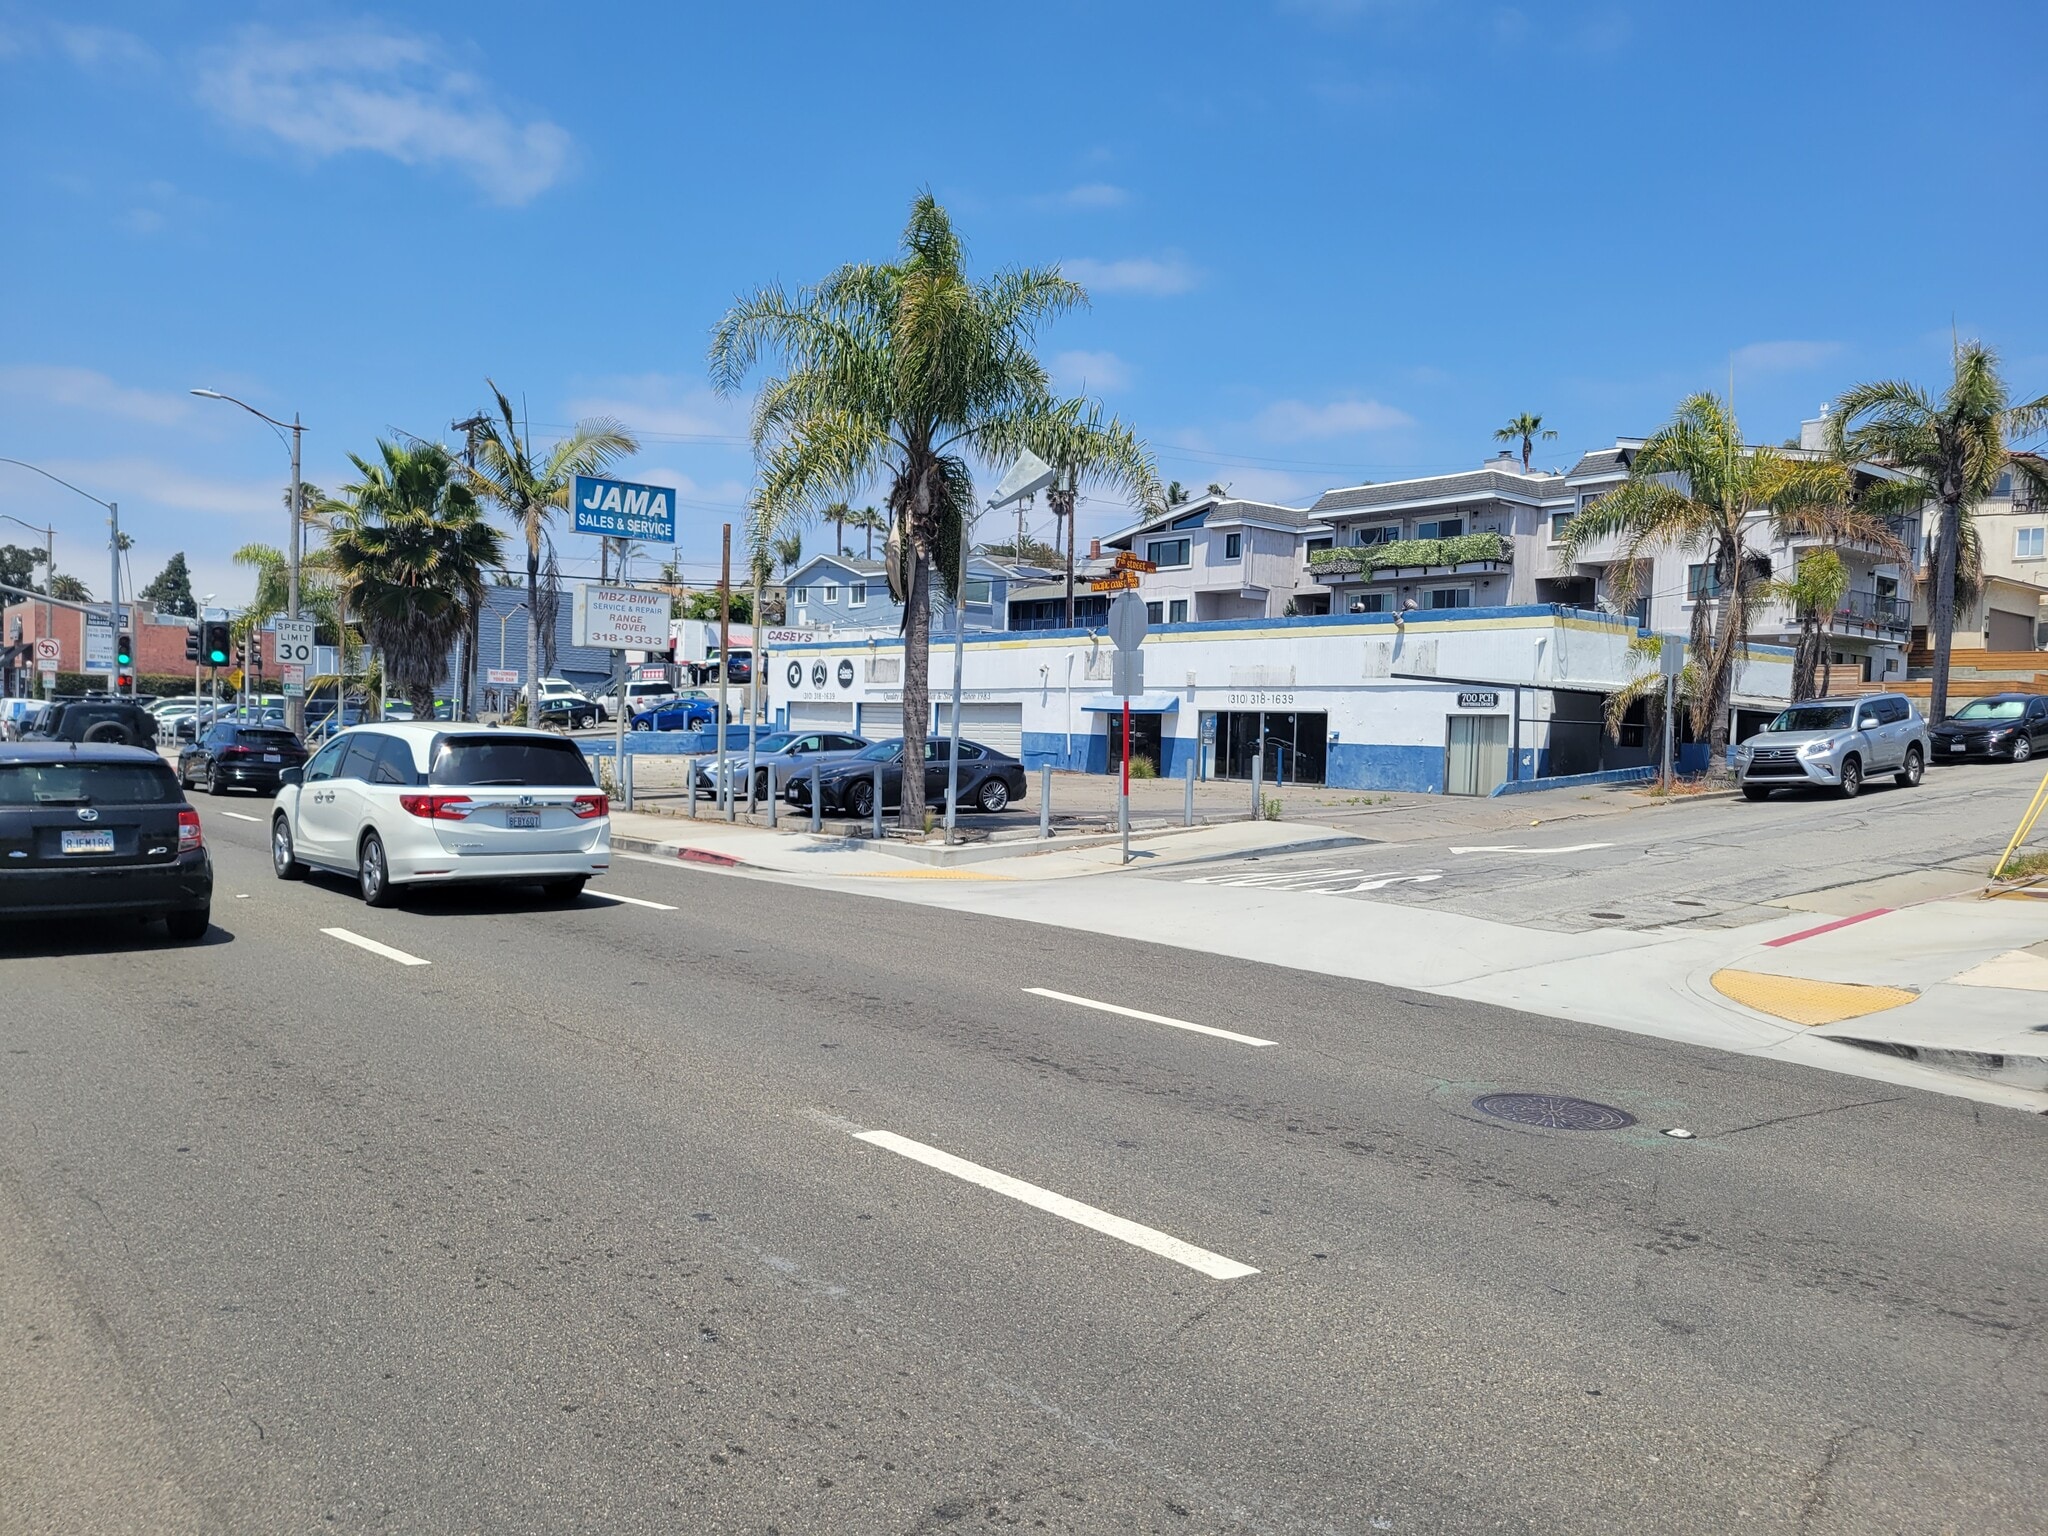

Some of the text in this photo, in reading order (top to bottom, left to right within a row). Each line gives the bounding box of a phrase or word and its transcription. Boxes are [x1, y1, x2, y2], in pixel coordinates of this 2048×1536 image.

[584, 485, 668, 518] JAMA
[579, 513, 672, 536] SALES & SERVICE
[593, 603, 626, 612] SERVICE
[636, 606, 662, 614] REPAIR
[610, 614, 643, 623] RANGE
[278, 623, 311, 632] SPEED
[615, 623, 646, 632] ROVER
[592, 632, 662, 645] 318-9333
[767, 630, 813, 643] CASEY'S
[280, 644, 309, 660] 30
[1228, 694, 1294, 704] (310) 318-1639
[1462, 693, 1494, 703] 700 PCH
